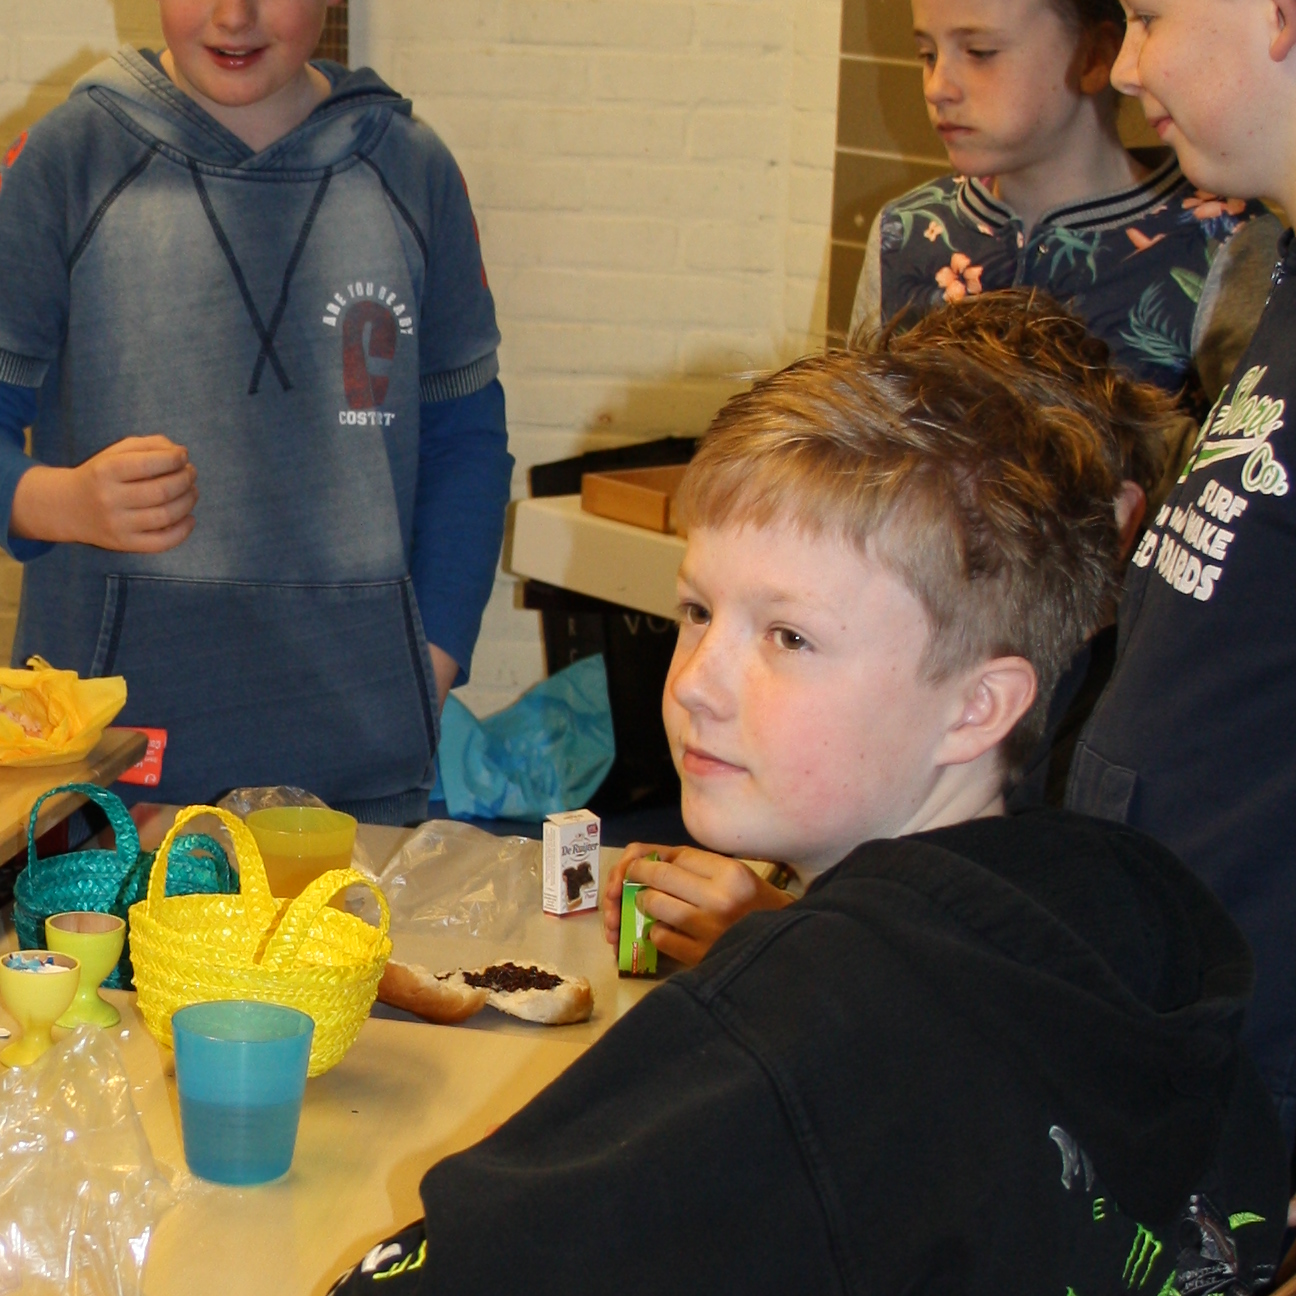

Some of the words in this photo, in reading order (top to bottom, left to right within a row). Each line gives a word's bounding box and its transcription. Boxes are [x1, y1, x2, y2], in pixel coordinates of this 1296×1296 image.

[322, 292, 347, 327] ARE
[347, 281, 374, 298] YOU
[1197, 478, 1249, 524] SURF
